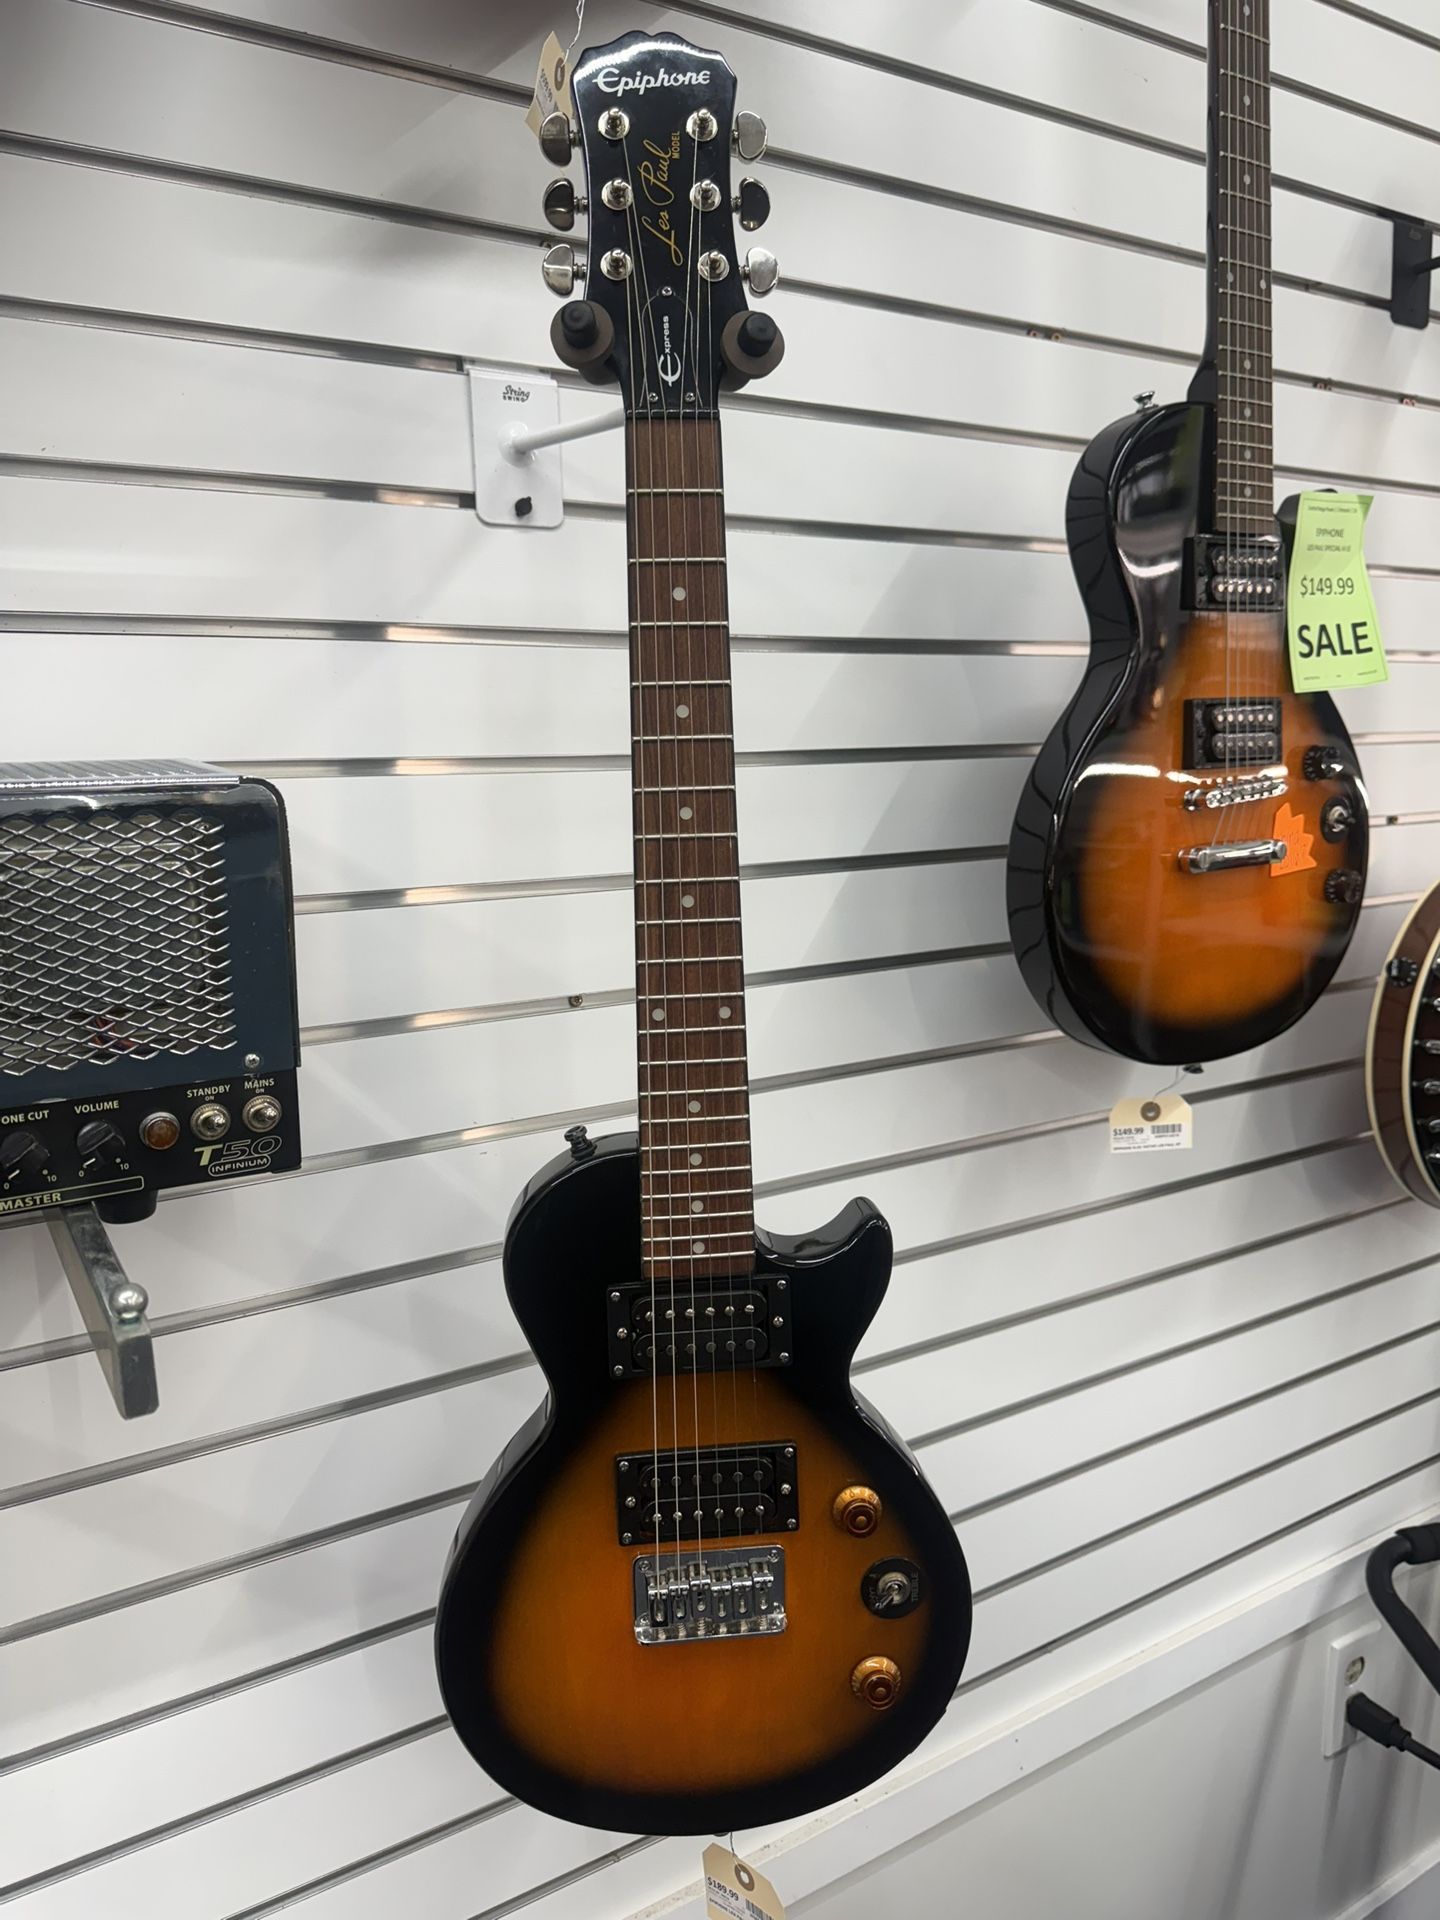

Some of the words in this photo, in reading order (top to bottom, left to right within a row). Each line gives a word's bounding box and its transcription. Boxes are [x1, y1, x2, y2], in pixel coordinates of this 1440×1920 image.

[592, 67, 711, 97] Epiphone
[671, 130, 681, 160] MODEL
[637, 139, 675, 206] Paul
[641, 210, 684, 266] Les
[1299, 575, 1355, 598] $149.99
[1297, 621, 1374, 659] SALE
[186, 1084, 231, 1098] STANDBY
[244, 1078, 275, 1090] MAINS
[27, 1109, 50, 1121] CUT
[74, 1100, 120, 1114] VOLUME
[194, 1135, 282, 1167] T50
[120, 1162, 130, 1170] 10
[211, 1158, 267, 1173] INFINIUM
[47, 1174, 57, 1182] 10
[0, 1192, 62, 1211] MASTER
